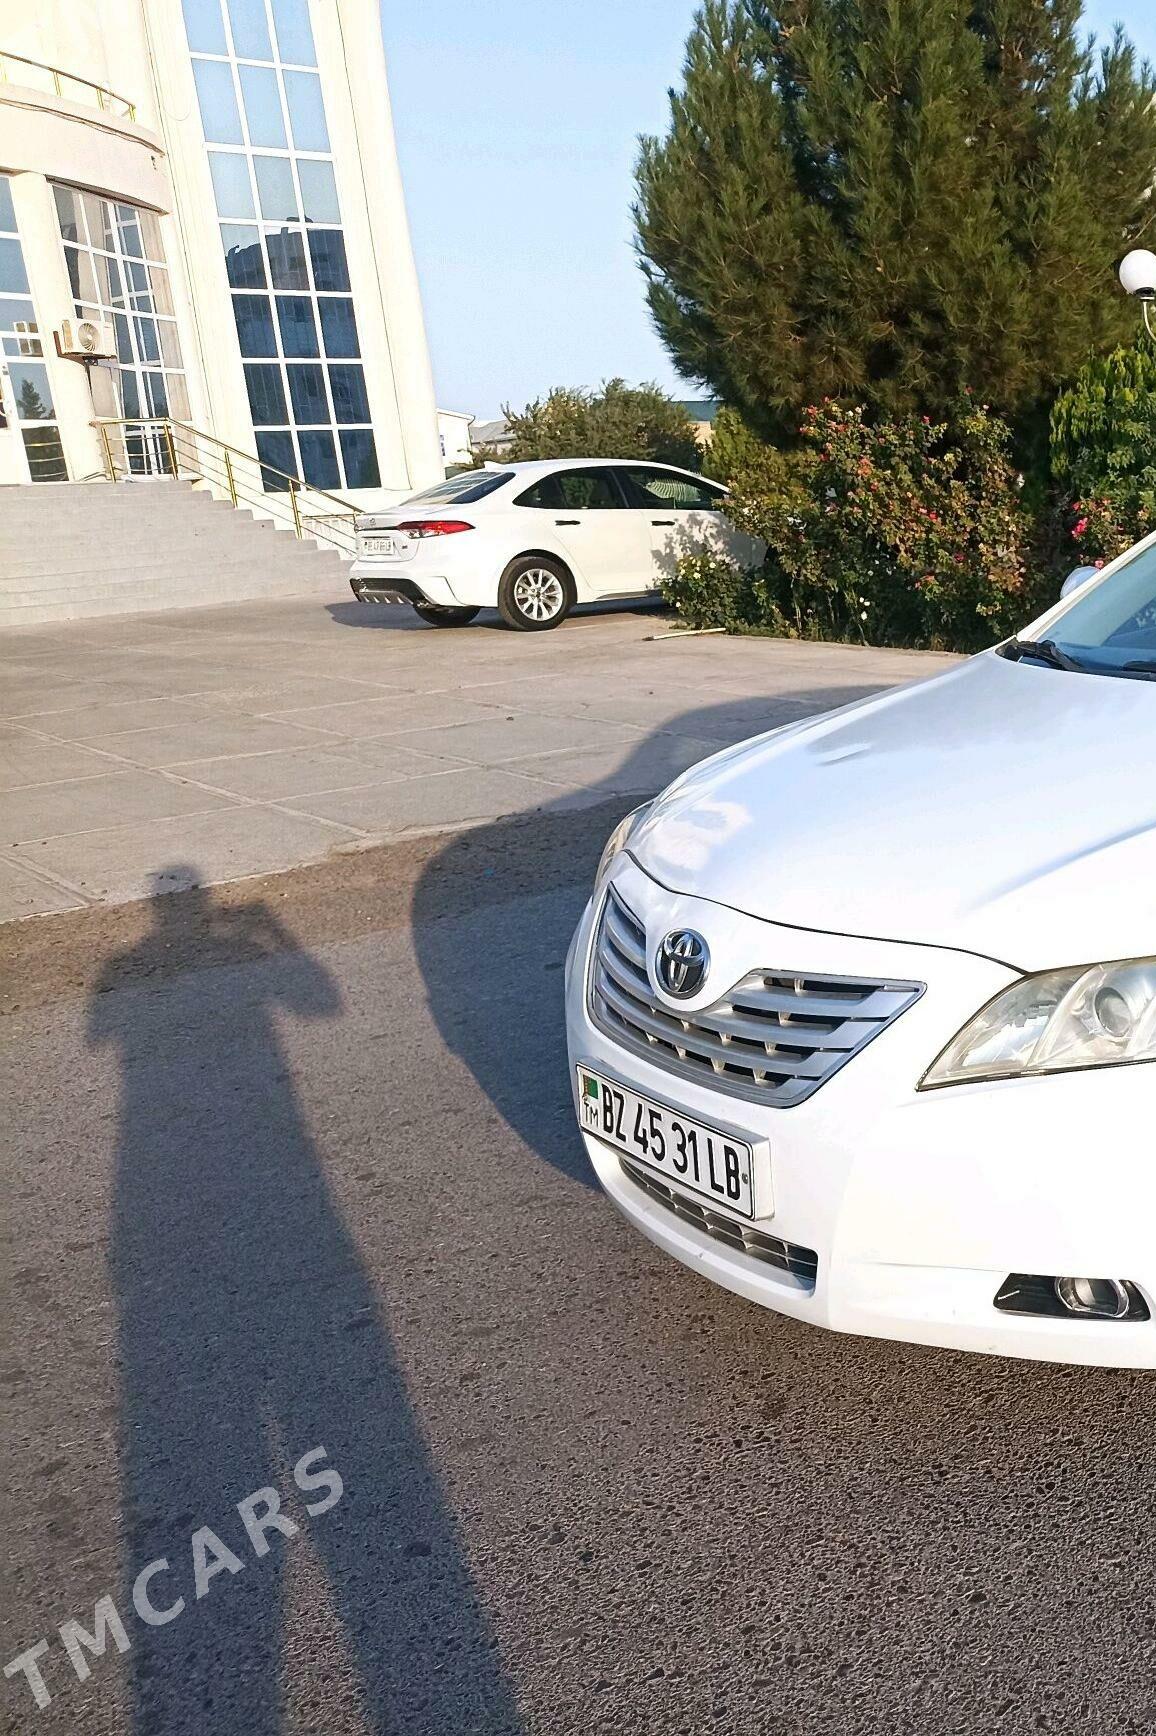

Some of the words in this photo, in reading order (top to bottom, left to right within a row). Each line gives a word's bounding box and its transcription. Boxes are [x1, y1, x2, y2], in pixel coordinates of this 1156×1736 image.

[583, 1100, 599, 1128] TM
[601, 1083, 627, 1143] BZ
[633, 1103, 667, 1162] 45
[672, 1121, 701, 1182] 31
[706, 1137, 741, 1201] LB
